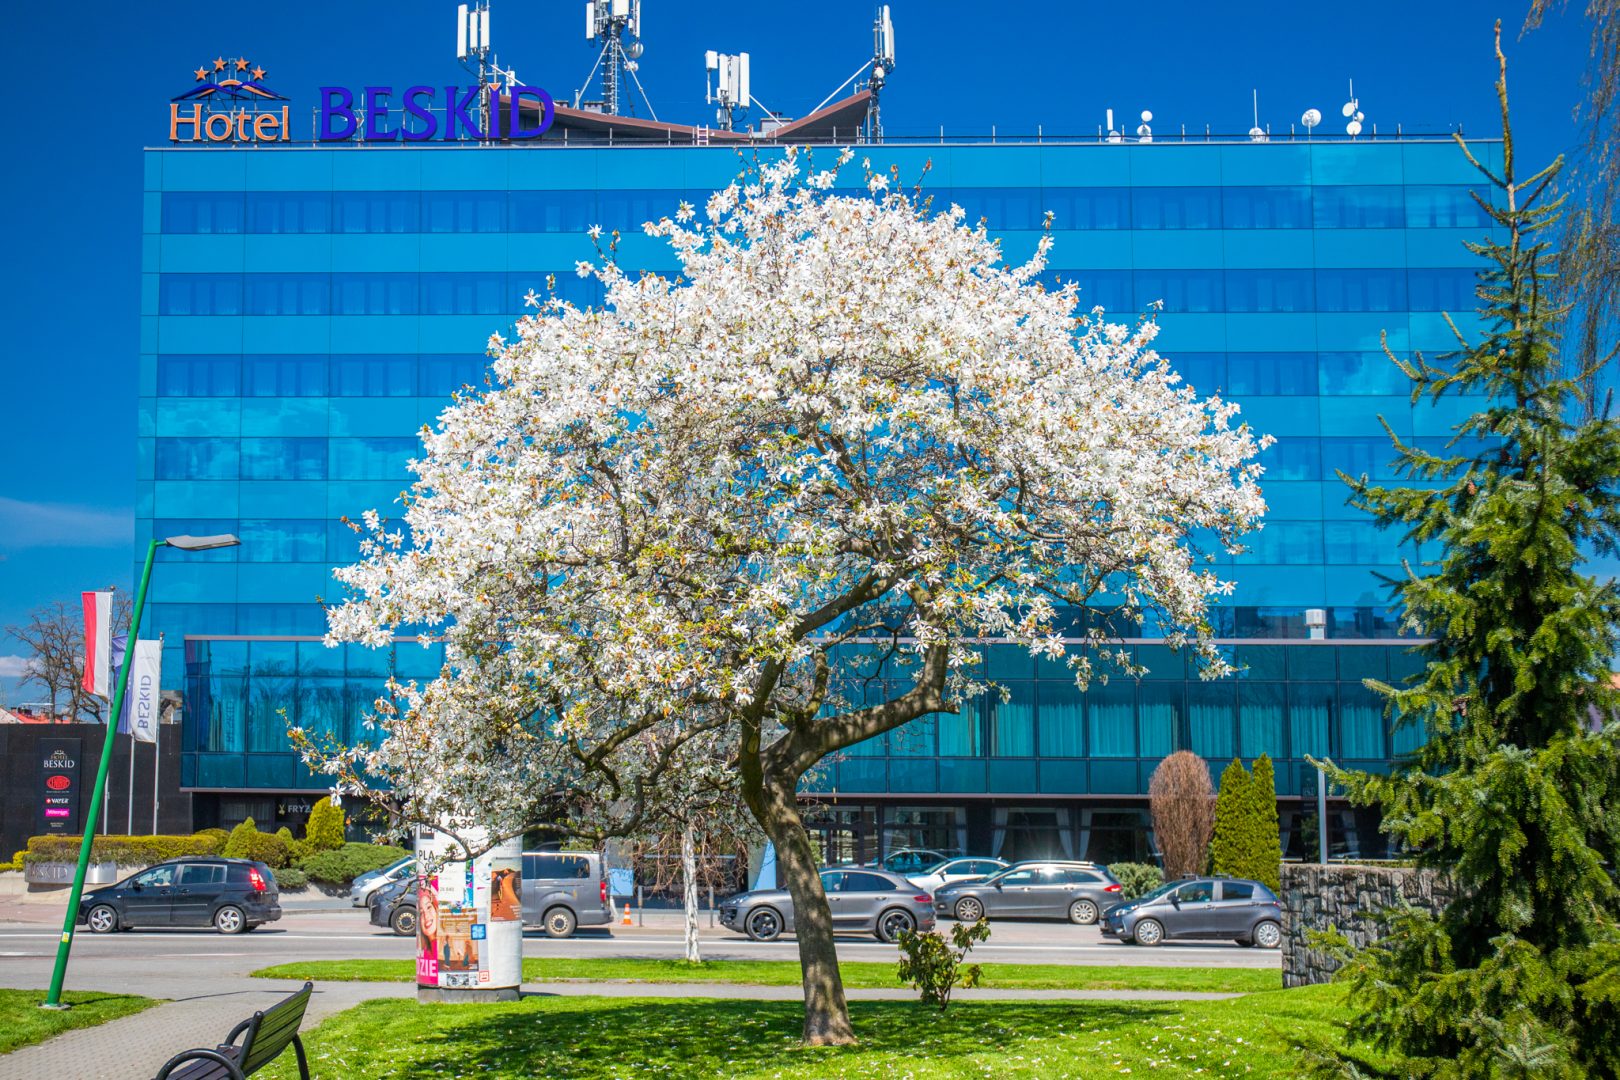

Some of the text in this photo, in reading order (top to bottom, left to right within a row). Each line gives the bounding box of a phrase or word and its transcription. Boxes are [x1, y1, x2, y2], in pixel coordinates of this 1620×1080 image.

[168, 85, 555, 141] Hotel BESKID
[43, 759, 75, 769] BESKID
[287, 804, 312, 813] FRYZ
